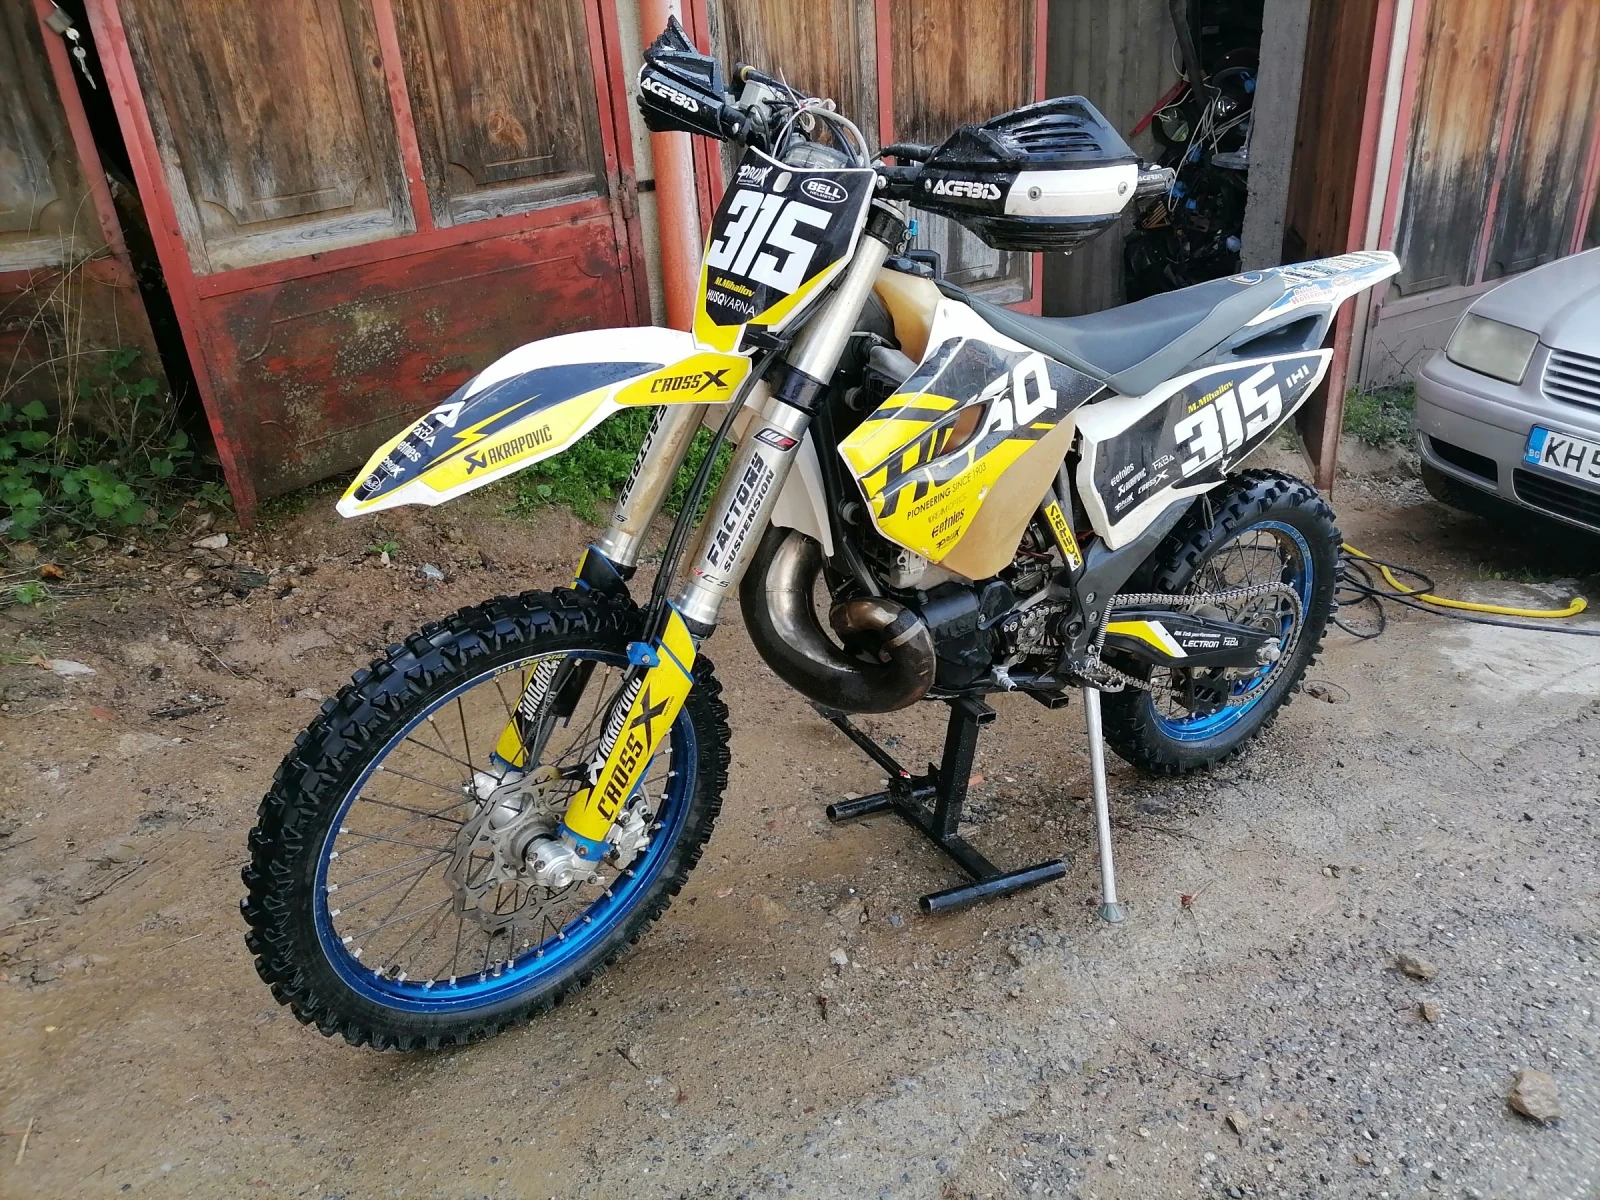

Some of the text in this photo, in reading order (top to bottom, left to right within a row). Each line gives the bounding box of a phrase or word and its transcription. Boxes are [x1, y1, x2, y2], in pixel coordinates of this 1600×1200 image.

[641, 78, 699, 112] ACERBIS
[807, 181, 841, 198] BELL
[932, 179, 1001, 200] ACERBIS
[705, 189, 833, 295] 315
[706, 288, 756, 317] HUSQVARNA
[714, 276, 755, 297] M.Mihailov
[1187, 380, 1234, 414] M.Mihailov
[1174, 362, 1283, 479] 315
[488, 424, 553, 465] AKRAPOVIČ
[760, 430, 795, 446] WP
[1529, 449, 1540, 459] BG
[907, 462, 987, 521] PIONEERING SINCE 1903
[707, 452, 765, 567] FACTORY
[724, 469, 775, 572] SUSPENSION
[1182, 639, 1220, 648] LECTRON
